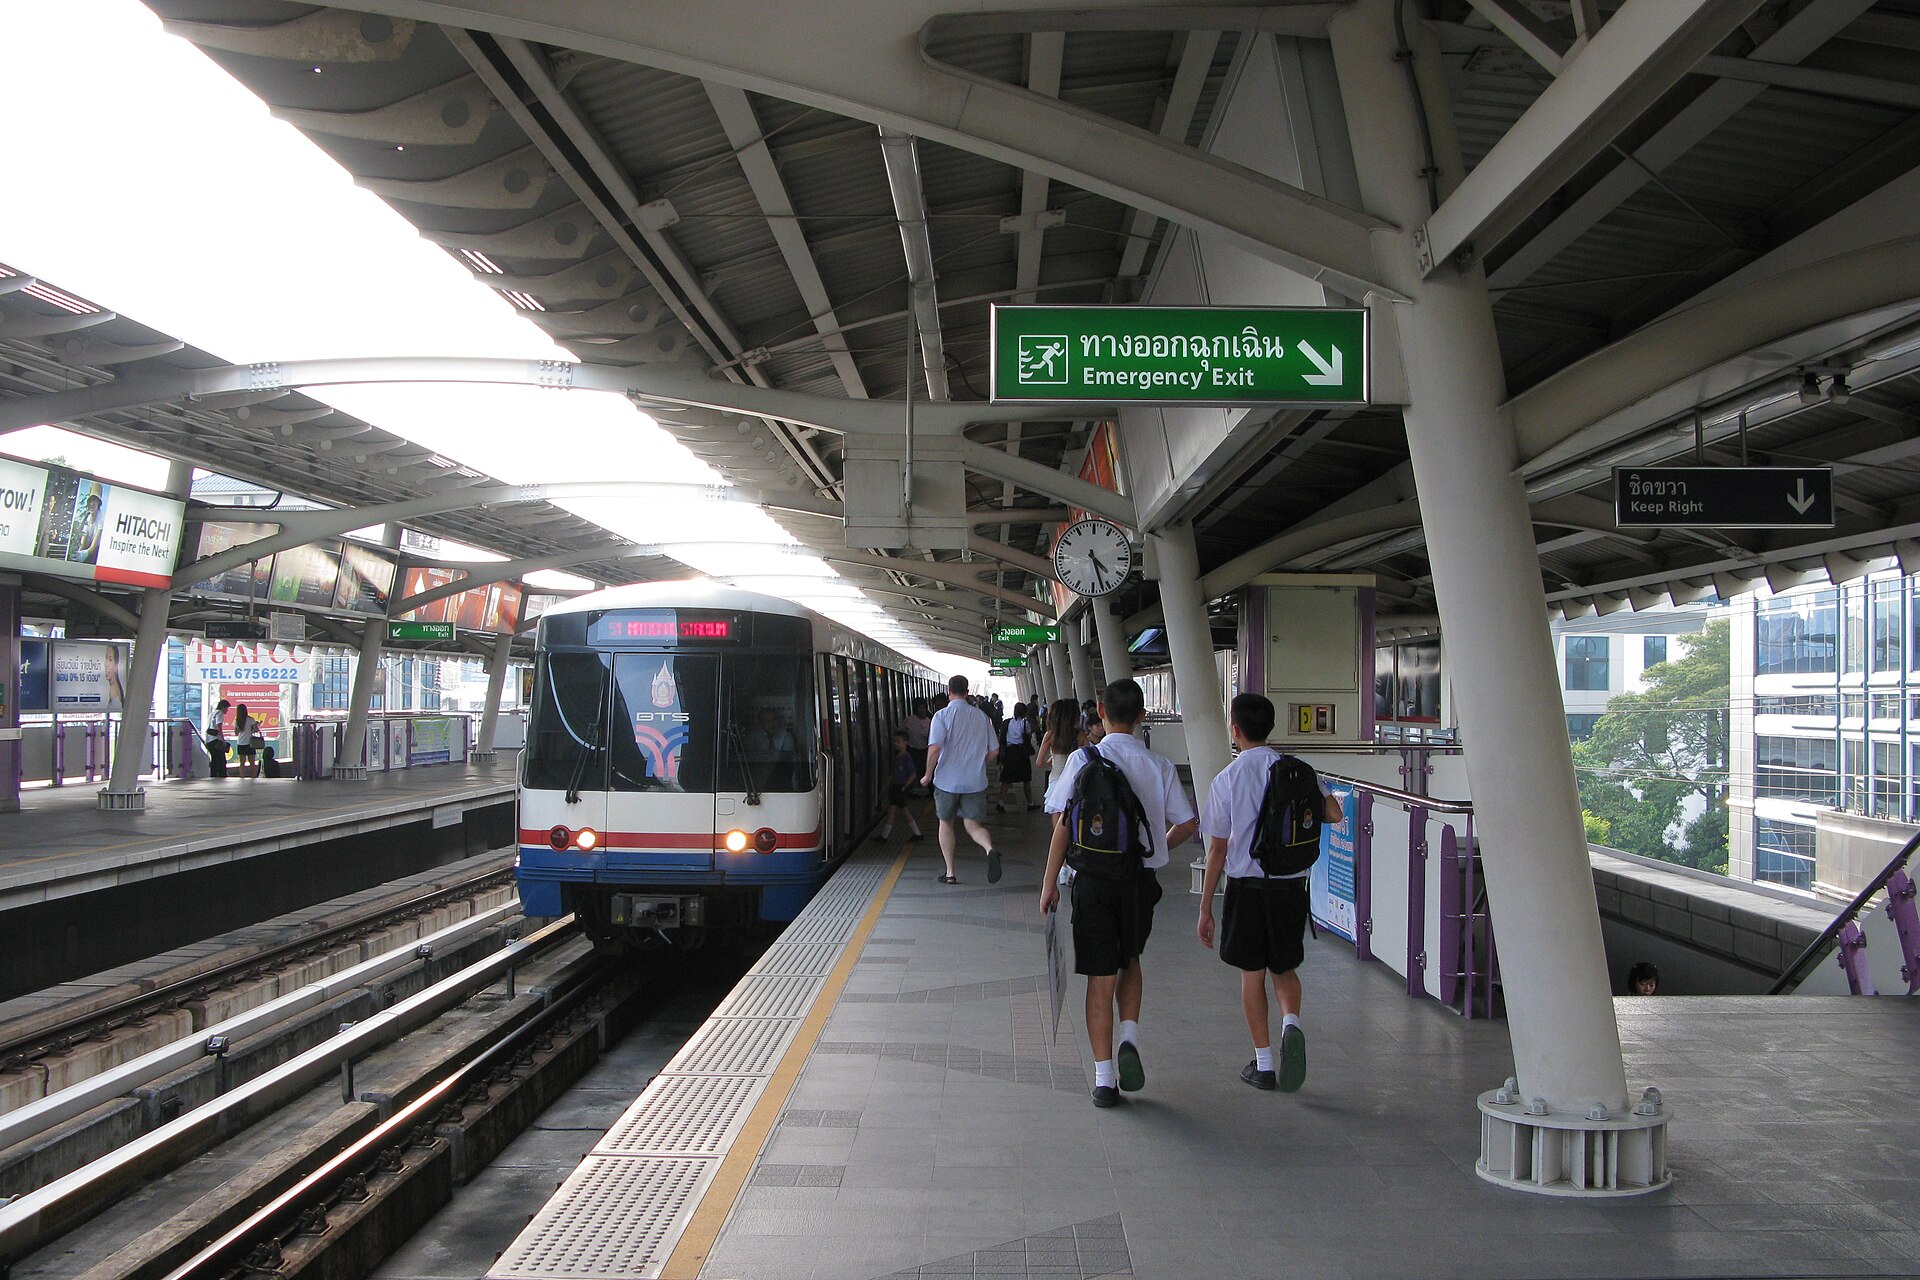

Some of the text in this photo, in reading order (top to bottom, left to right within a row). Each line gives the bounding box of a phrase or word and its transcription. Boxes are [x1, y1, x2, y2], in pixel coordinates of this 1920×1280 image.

[1080, 326, 1284, 371] ทางออกฉุกเฉิน
[1083, 367, 1255, 390] Emergency Exit
[1629, 474, 1687, 496] ชิดขวา
[1631, 500, 1704, 515] Keep Right
[116, 513, 171, 542] HITACHI
[109, 536, 169, 559] Inspire the Next
[636, 712, 690, 722] BTS
